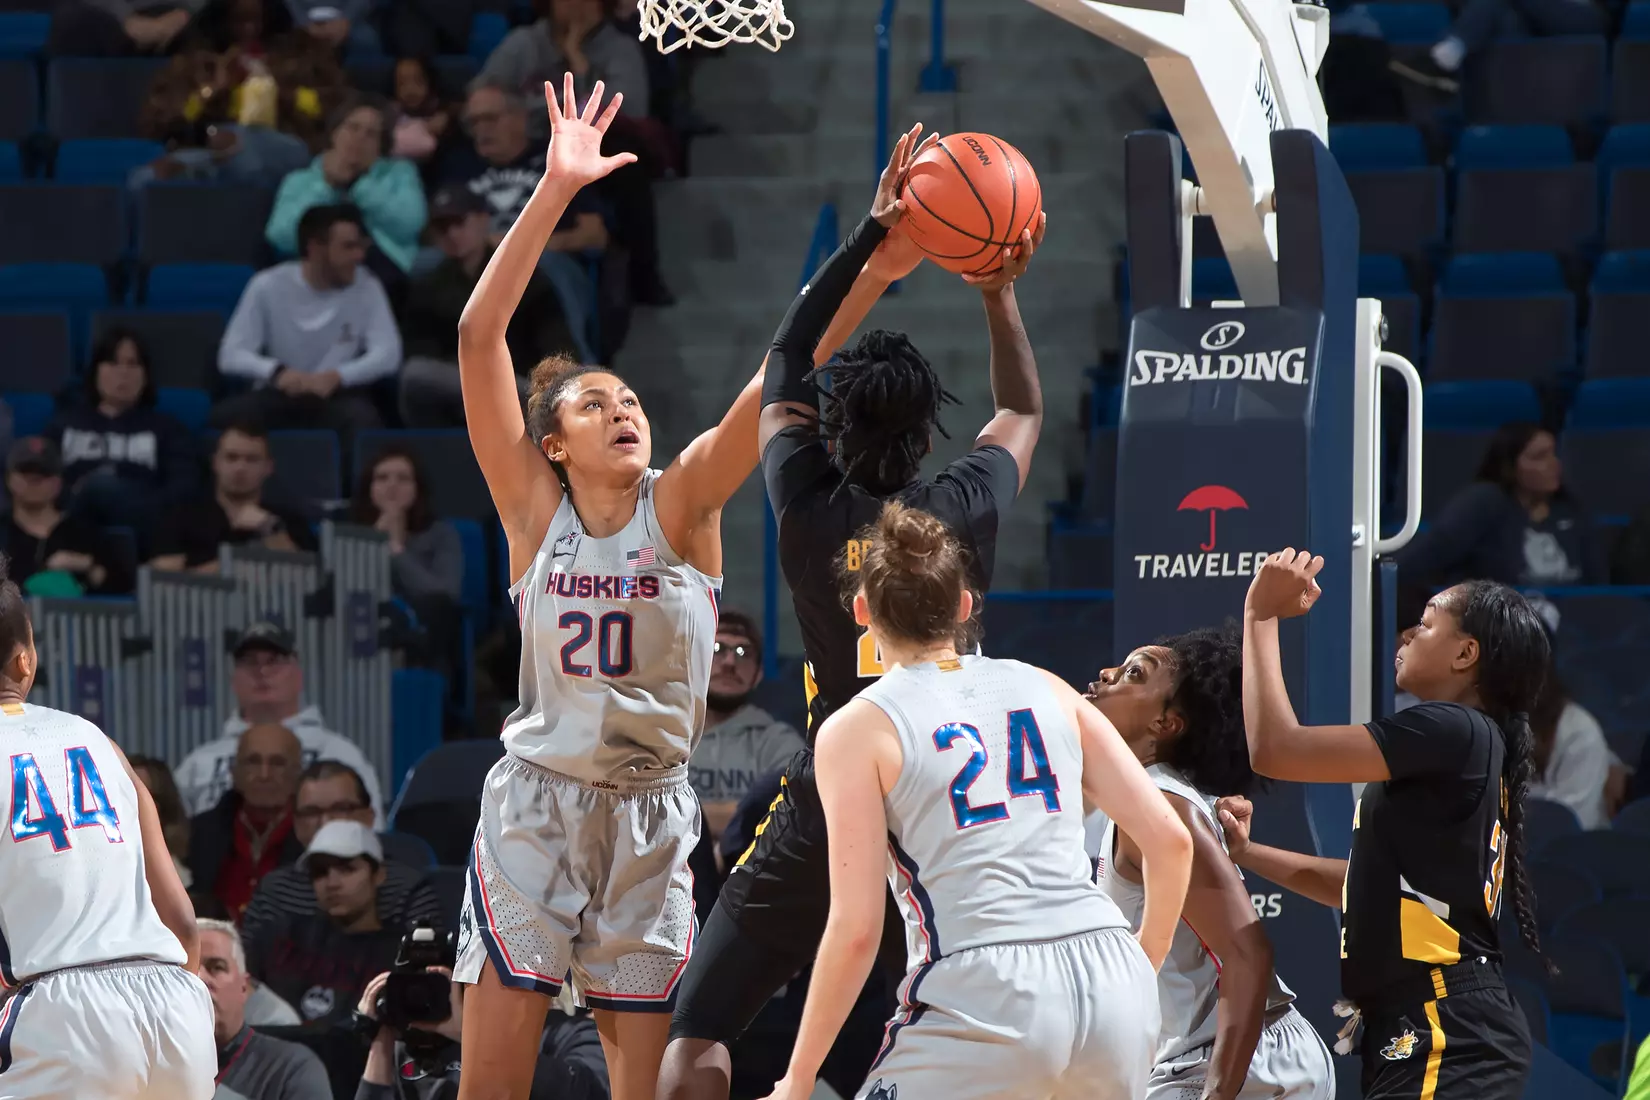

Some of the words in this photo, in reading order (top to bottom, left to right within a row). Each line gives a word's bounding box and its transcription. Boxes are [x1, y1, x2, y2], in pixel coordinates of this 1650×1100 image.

[963, 136, 992, 166] UCONN
[1131, 347, 1307, 386] SPALDING
[545, 572, 660, 599] HUSKIES
[558, 610, 634, 678] 20
[592, 780, 619, 791] UCONN
[932, 707, 1062, 830] 24
[9, 745, 124, 853] 44
